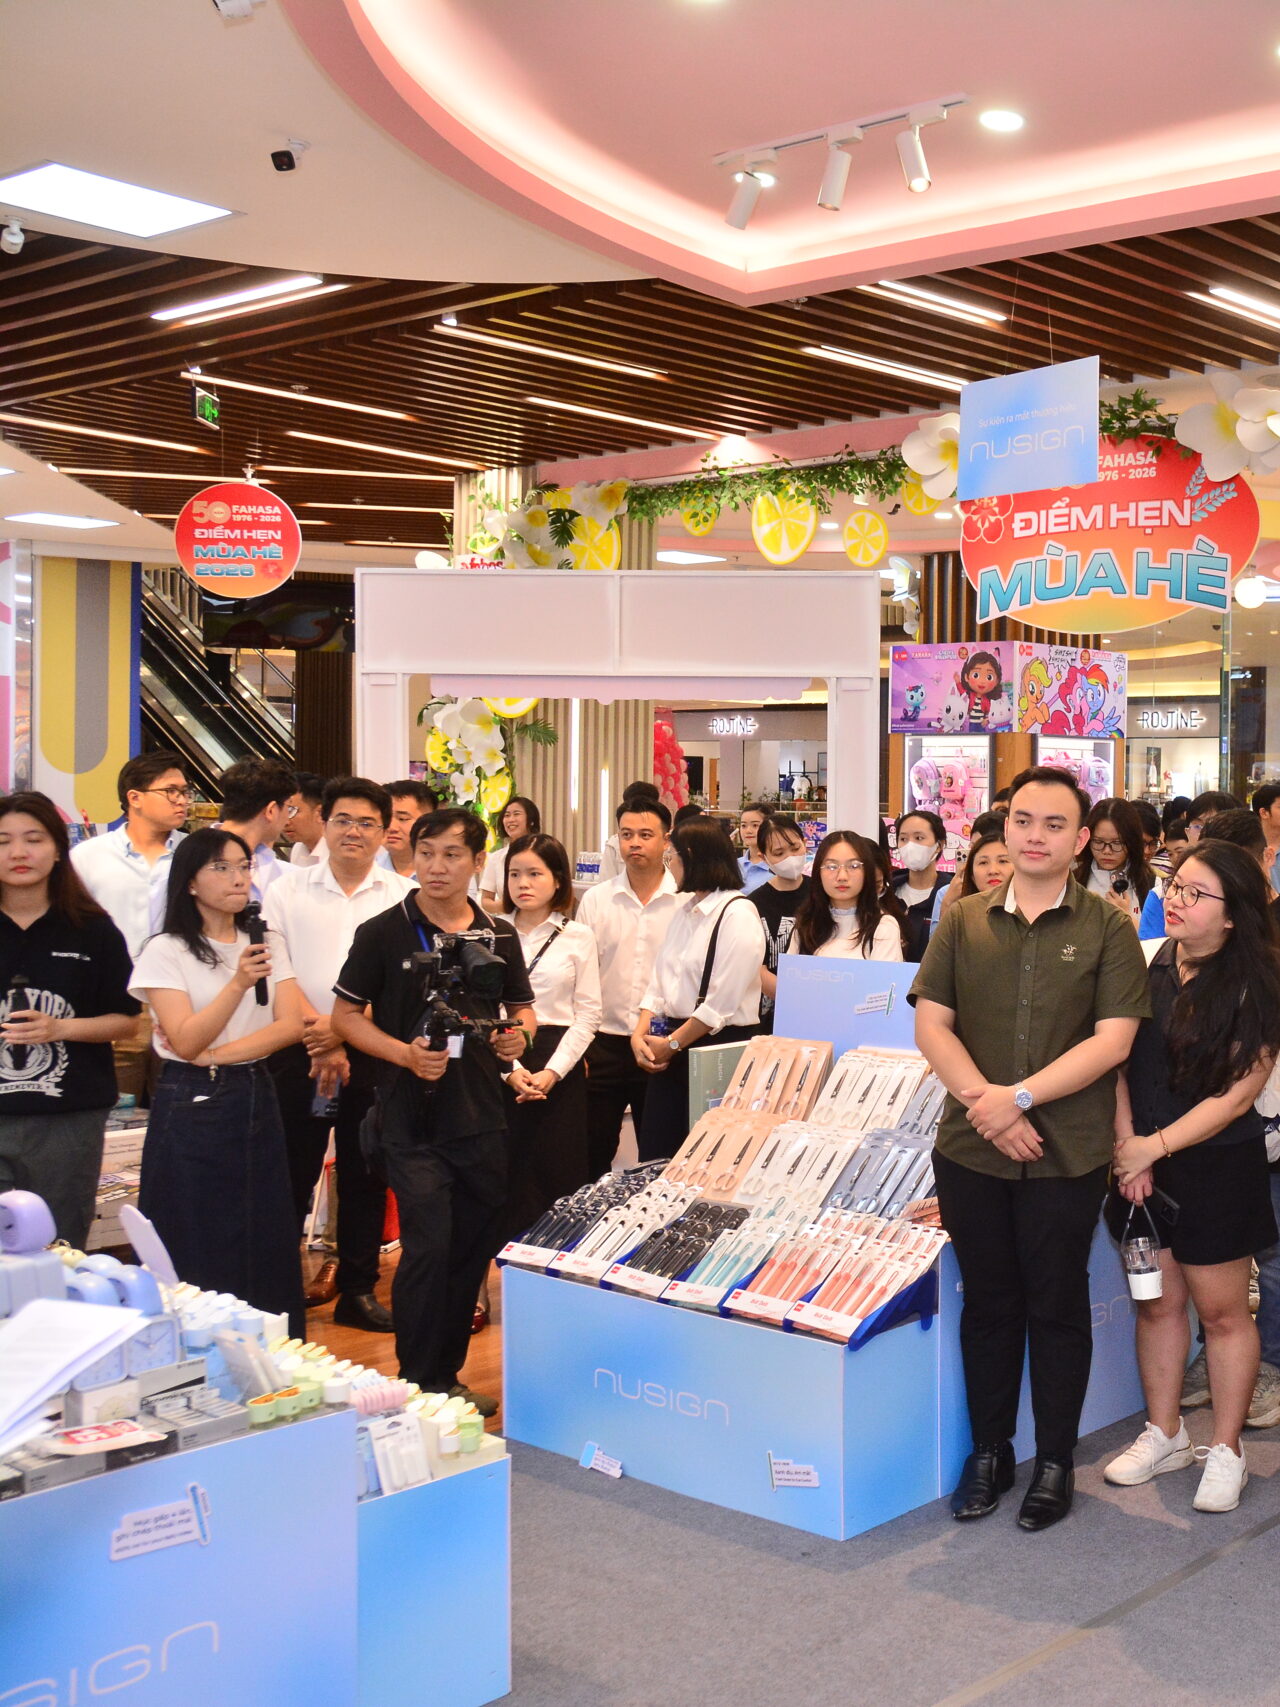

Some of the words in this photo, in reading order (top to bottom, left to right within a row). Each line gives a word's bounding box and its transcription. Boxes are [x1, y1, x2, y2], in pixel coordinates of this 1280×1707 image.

[1098, 470, 1117, 481] 976
[1129, 467, 1156, 480] 2026
[192, 501, 231, 524] 50
[232, 505, 281, 514] FAHASA
[232, 514, 252, 522] 1976
[1012, 497, 1103, 538] ĐIỂM
[1109, 498, 1191, 535] HẸN
[193, 525, 241, 539] ĐIỂM
[243, 529, 281, 542] HẸN
[194, 541, 249, 558] MÙA
[251, 542, 283, 559] HÈ
[978, 542, 1127, 622] MÙA
[1134, 536, 1230, 611] HÈ
[712, 716, 752, 734] ROUTINE
[1142, 708, 1198, 730] ROUTINE
[0, 1621, 219, 1707] SIGN
